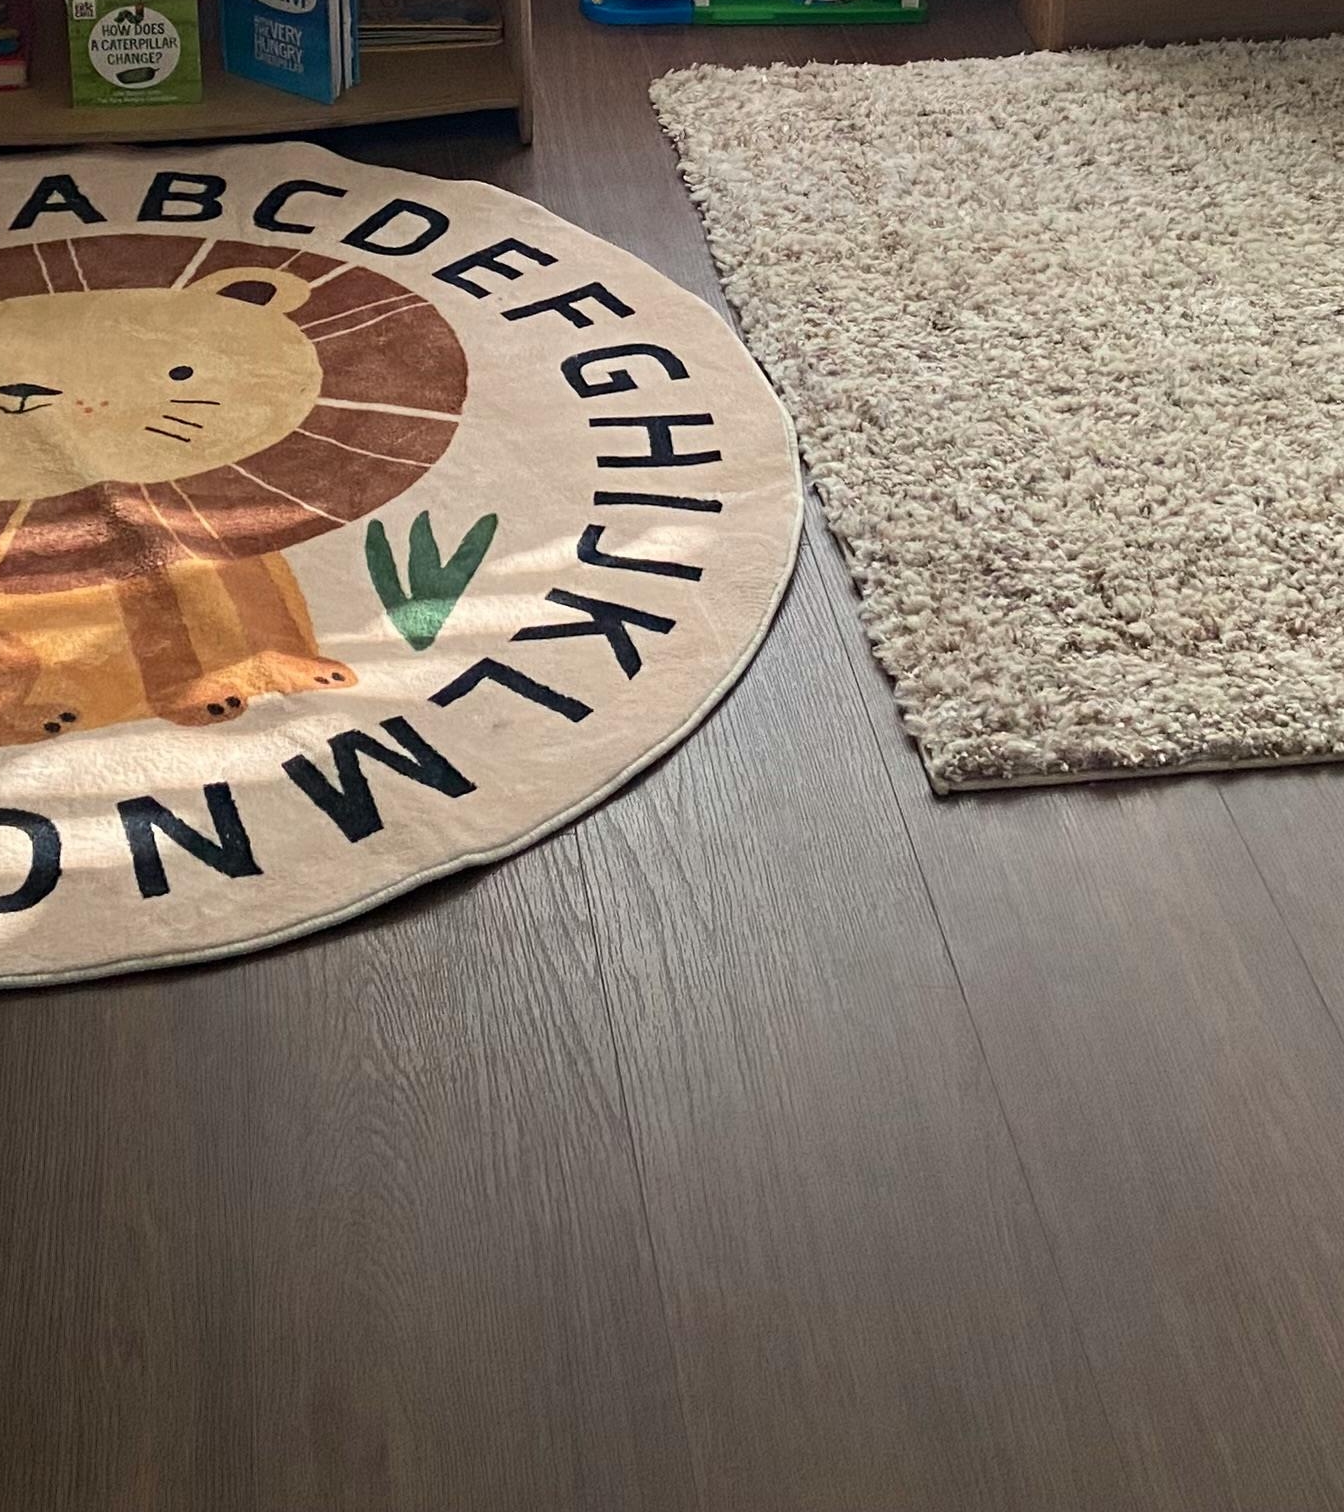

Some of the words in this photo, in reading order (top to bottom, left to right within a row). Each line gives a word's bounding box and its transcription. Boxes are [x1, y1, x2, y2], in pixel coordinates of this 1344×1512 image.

[102, 24, 132, 37] HOW
[134, 23, 165, 35] DOES
[270, 20, 303, 47] VERY
[91, 41, 99, 52] A
[101, 37, 178, 51] CATERPILLAR
[254, 33, 303, 64] HUNGRY
[107, 51, 163, 65] CHANGE?
